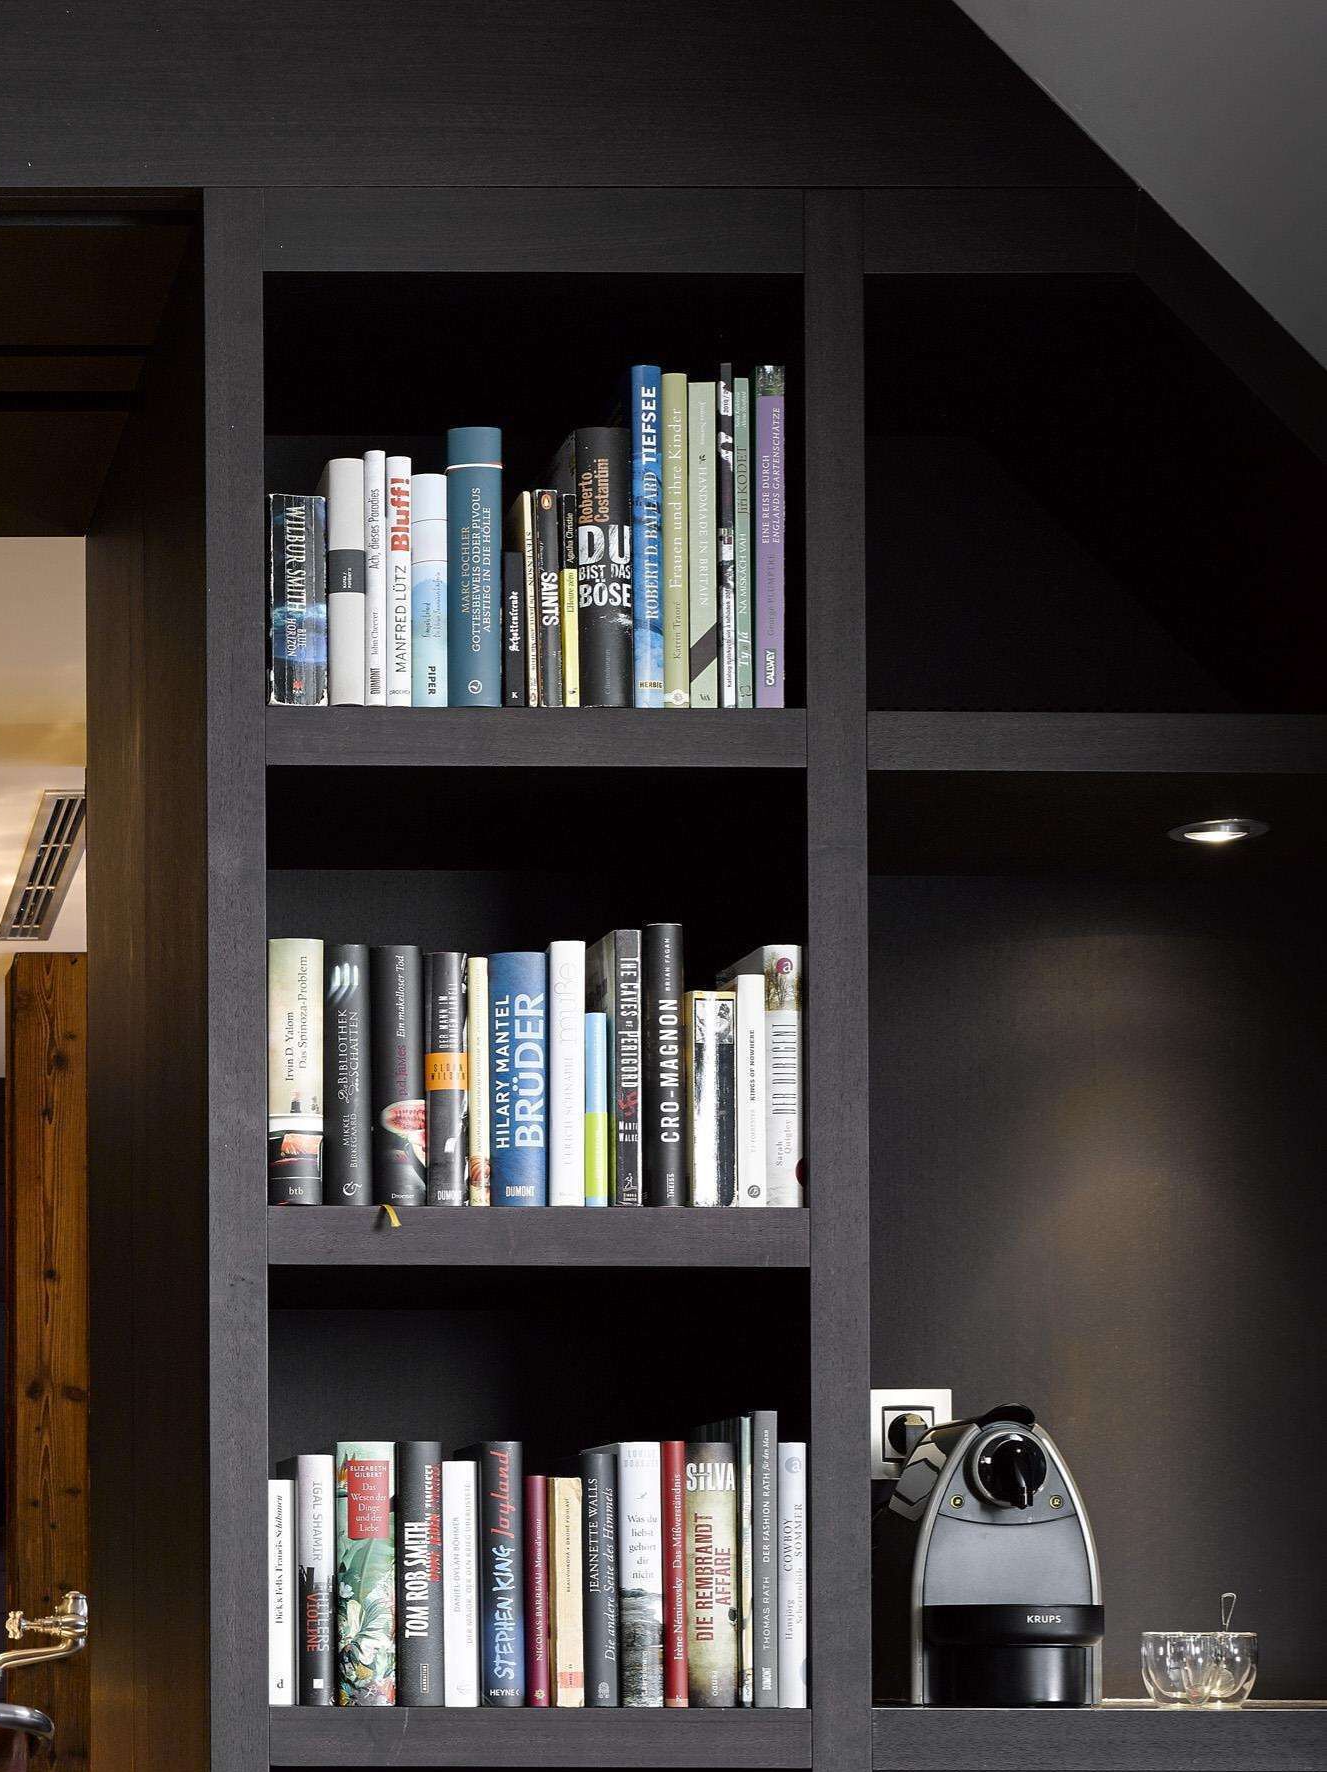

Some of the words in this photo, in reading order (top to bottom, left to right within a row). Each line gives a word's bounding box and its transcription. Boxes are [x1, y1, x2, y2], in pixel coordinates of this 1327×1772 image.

[641, 386, 657, 465] TIEFSEE
[578, 472, 593, 525] Roberto
[594, 458, 610, 523] Costantini
[642, 471, 659, 540] BALLARD
[285, 506, 306, 564] WILBUR
[390, 477, 410, 552] Bluff!
[578, 525, 631, 566] DU
[644, 545, 657, 557] D.
[285, 567, 307, 612] SMITH
[392, 564, 407, 600] LÜTZ
[578, 564, 607, 581] BIST
[610, 563, 632, 580] DAS
[578, 579, 632, 608] BÖSE
[644, 560, 660, 619] ROBERT
[541, 571, 559, 627] SAINTS
[286, 618, 297, 657] HORIZON
[394, 605, 407, 673] MANFRED
[427, 665, 437, 695] PIPER
[766, 649, 776, 686] CALLWEY
[619, 957, 639, 977] THE
[663, 937, 671, 963] FAGAN
[297, 955, 308, 1048] Spinoza-Problem
[620, 982, 639, 1017] CAVES
[663, 966, 671, 992] BRIAN
[337, 1009, 349, 1084] BIBLIOTHEK
[348, 1010, 360, 1077] SCHATTEN
[494, 994, 510, 1073] MANTEL
[771, 1023, 797, 1085] DIRIGENT
[298, 1050, 308, 1069] Das
[512, 992, 545, 1148] BRÜDER
[618, 1030, 640, 1089] PERIGORD
[658, 999, 680, 1144] CRO-MAGNON
[495, 1079, 510, 1149] HILARY
[771, 1093, 797, 1115] DER
[349, 1112, 358, 1169] BIRKEGAARD
[505, 1185, 536, 1198] DUMONT
[312, 1480, 323, 1511] IGAL
[489, 1450, 515, 1540] Joyland
[587, 1477, 599, 1517] WALLS
[685, 1462, 736, 1492] SILVA
[763, 1473, 771, 1498] RATH
[601, 1488, 615, 1540] Himmels
[670, 1474, 683, 1548] Mißverständnis
[763, 1501, 771, 1542] FASHION
[794, 1503, 804, 1559] SOMMER
[312, 1512, 323, 1562] SHAMIR
[403, 1521, 430, 1567] SMITH
[588, 1520, 601, 1594] JEANNETTE
[603, 1543, 615, 1561] des
[763, 1545, 771, 1564] DER
[783, 1518, 793, 1573] COWBOY
[491, 1545, 516, 1592] KING
[604, 1565, 615, 1592] Seite
[672, 1551, 683, 1569] Das
[694, 1512, 715, 1610] REMBRANDT
[404, 1570, 429, 1601] ROB
[671, 1576, 685, 1634] Némirovsky
[763, 1576, 771, 1604] RATH
[306, 1592, 319, 1652] VIOLINE
[316, 1591, 330, 1652] HITLERS
[404, 1605, 429, 1639] TOM
[606, 1596, 616, 1635] andere
[695, 1616, 714, 1641] DIE
[763, 1607, 771, 1652] THOMAS
[1027, 1614, 1062, 1624] KRUPS
[492, 1597, 517, 1681] STEPHEN
[604, 1639, 617, 1661] Die
[673, 1636, 684, 1661] Irène
